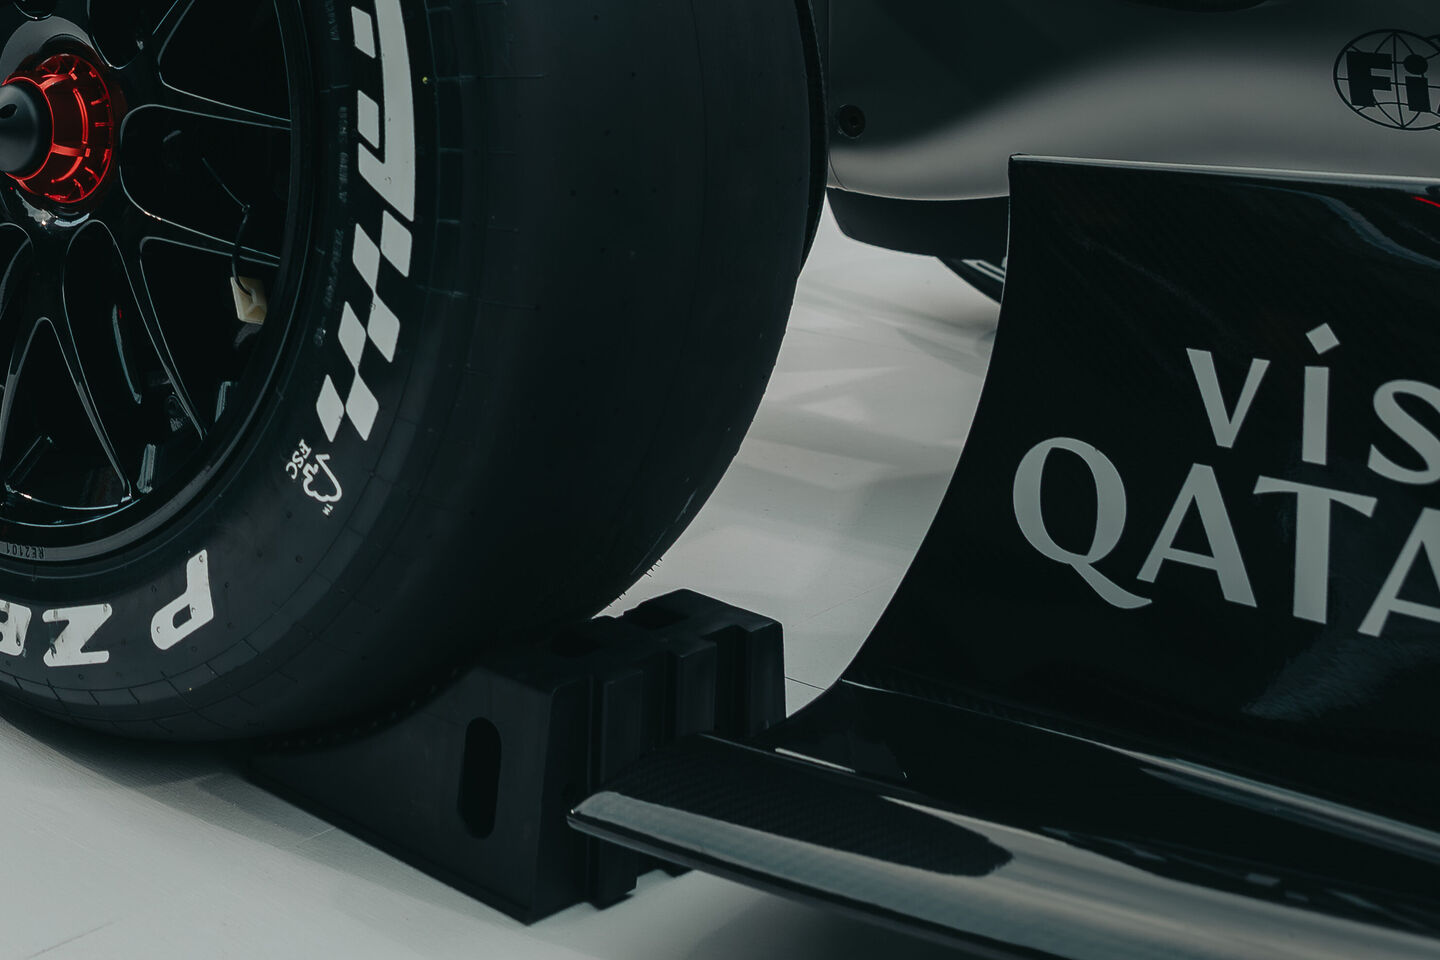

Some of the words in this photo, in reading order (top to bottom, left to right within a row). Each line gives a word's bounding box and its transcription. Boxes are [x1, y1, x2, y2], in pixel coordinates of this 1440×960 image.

[1347, 51, 1440, 114] Fi
[286, 439, 312, 480] FSC
[151, 549, 215, 651] P
